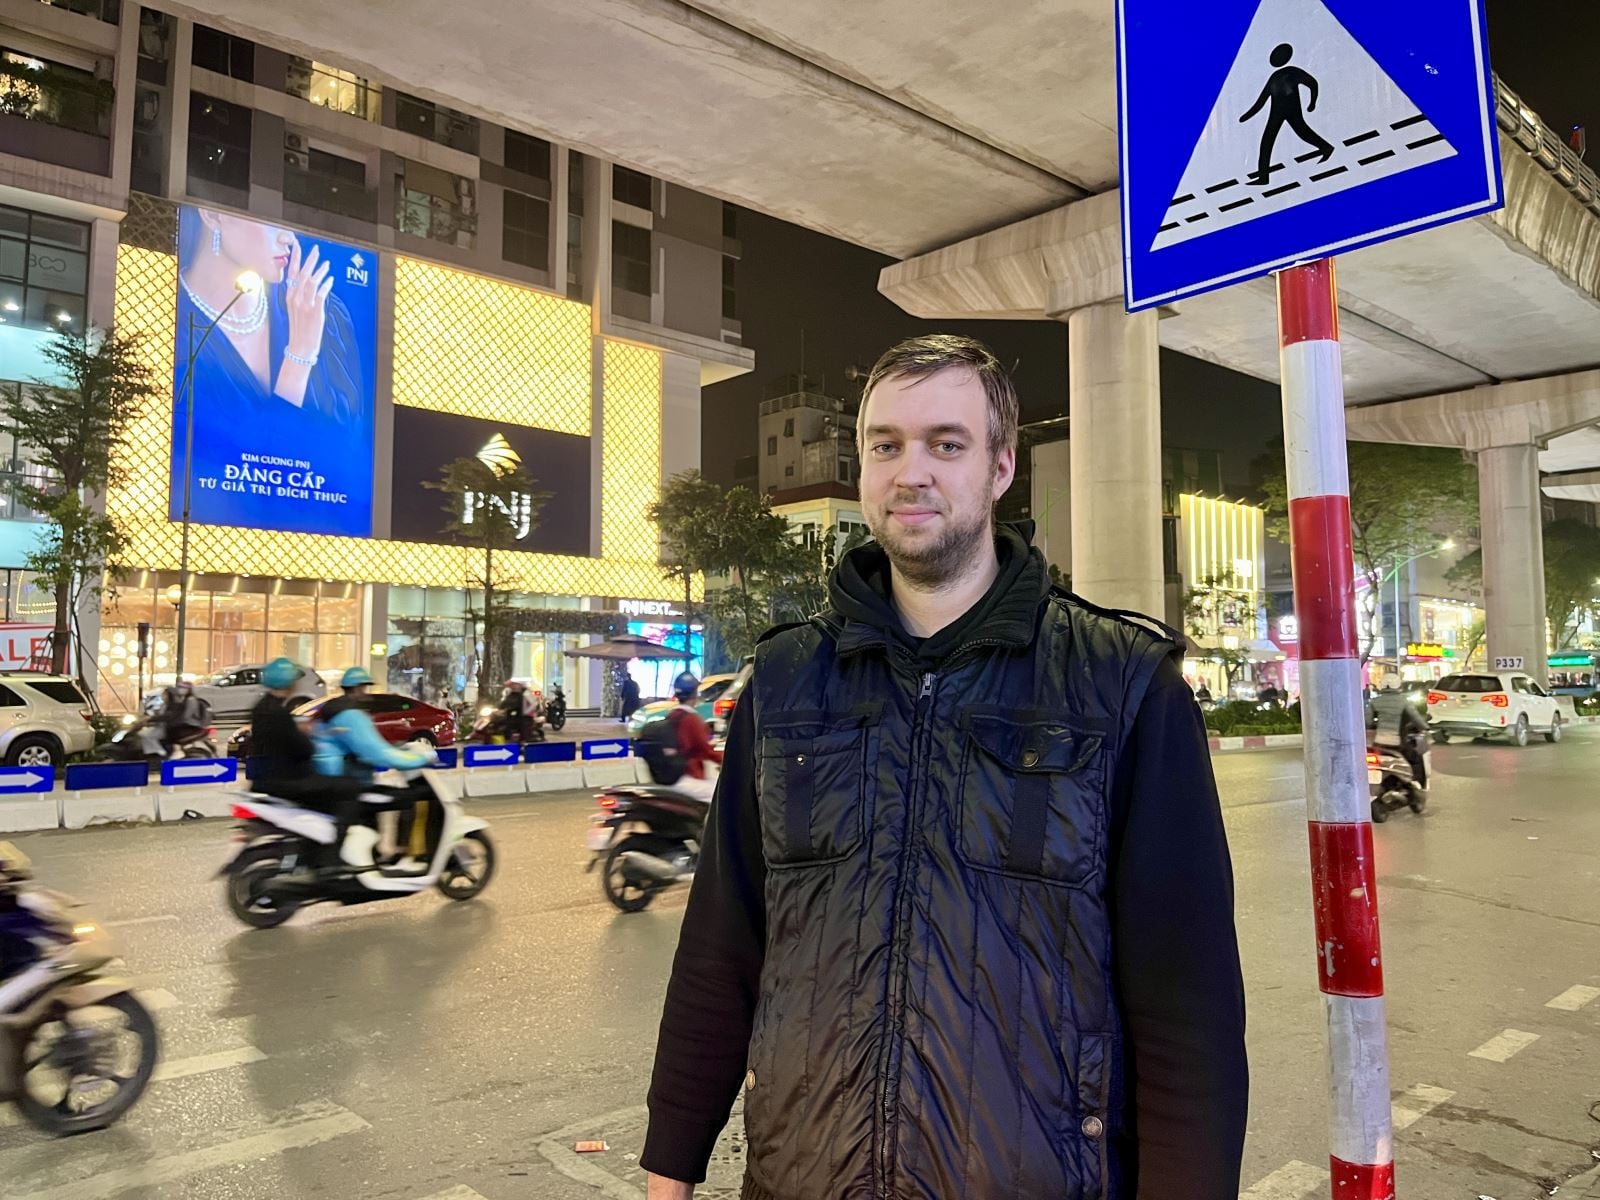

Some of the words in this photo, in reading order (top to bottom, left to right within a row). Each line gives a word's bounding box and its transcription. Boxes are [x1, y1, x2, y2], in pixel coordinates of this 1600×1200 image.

[346, 266, 369, 285] PNJ
[241, 452, 260, 463] KIM
[260, 455, 294, 467] CƯƠNG
[295, 459, 311, 470] PNJ
[224, 463, 283, 485] ĐẲNG
[287, 471, 326, 490] CẤP
[198, 477, 218, 489] TỪ
[221, 480, 246, 493] GIÁ
[250, 484, 272, 497] TRỊ
[276, 486, 309, 500] ĐÍCH
[313, 490, 348, 504] THỰC
[1495, 658, 1522, 668] P337
